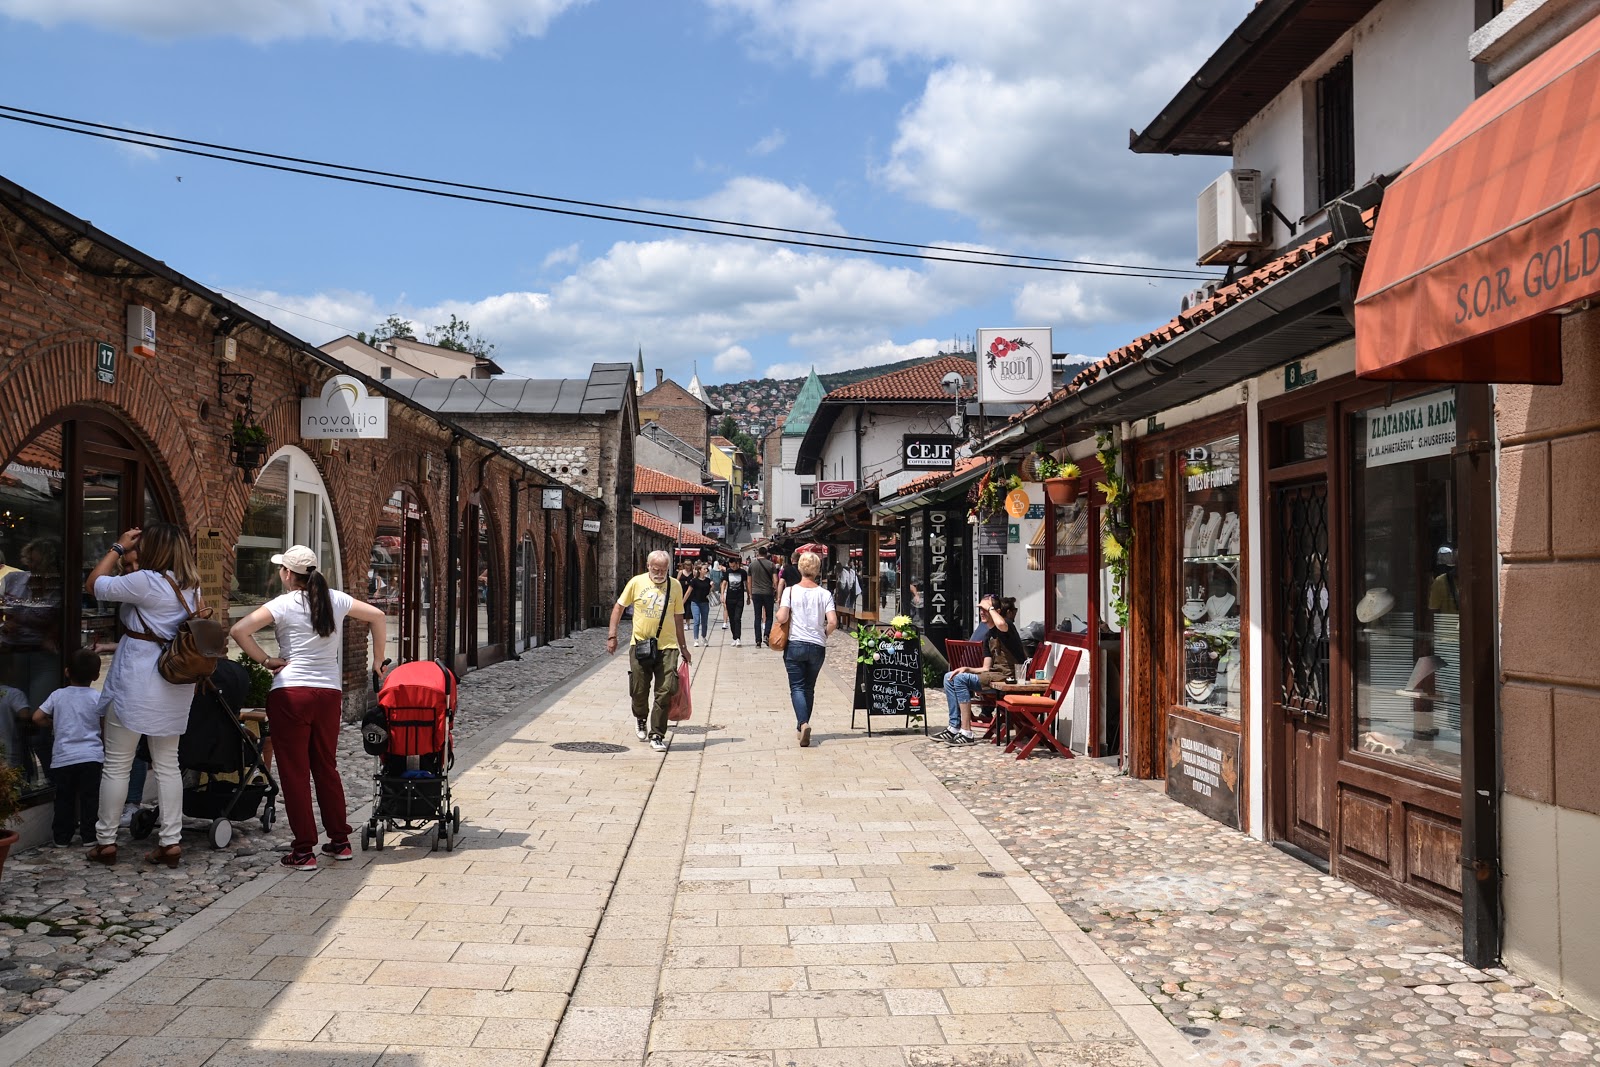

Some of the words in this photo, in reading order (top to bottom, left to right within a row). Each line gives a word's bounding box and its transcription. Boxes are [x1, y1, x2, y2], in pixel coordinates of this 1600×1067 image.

[1523, 228, 1600, 297] GOLD
[101, 349, 113, 366] 17
[1001, 361, 1026, 375] KOD
[1026, 356, 1034, 380] 1
[1289, 367, 1296, 384] 8
[307, 413, 378, 428] novalija
[1372, 407, 1424, 440] ZLATARSKA
[1010, 526, 1017, 535] 4
